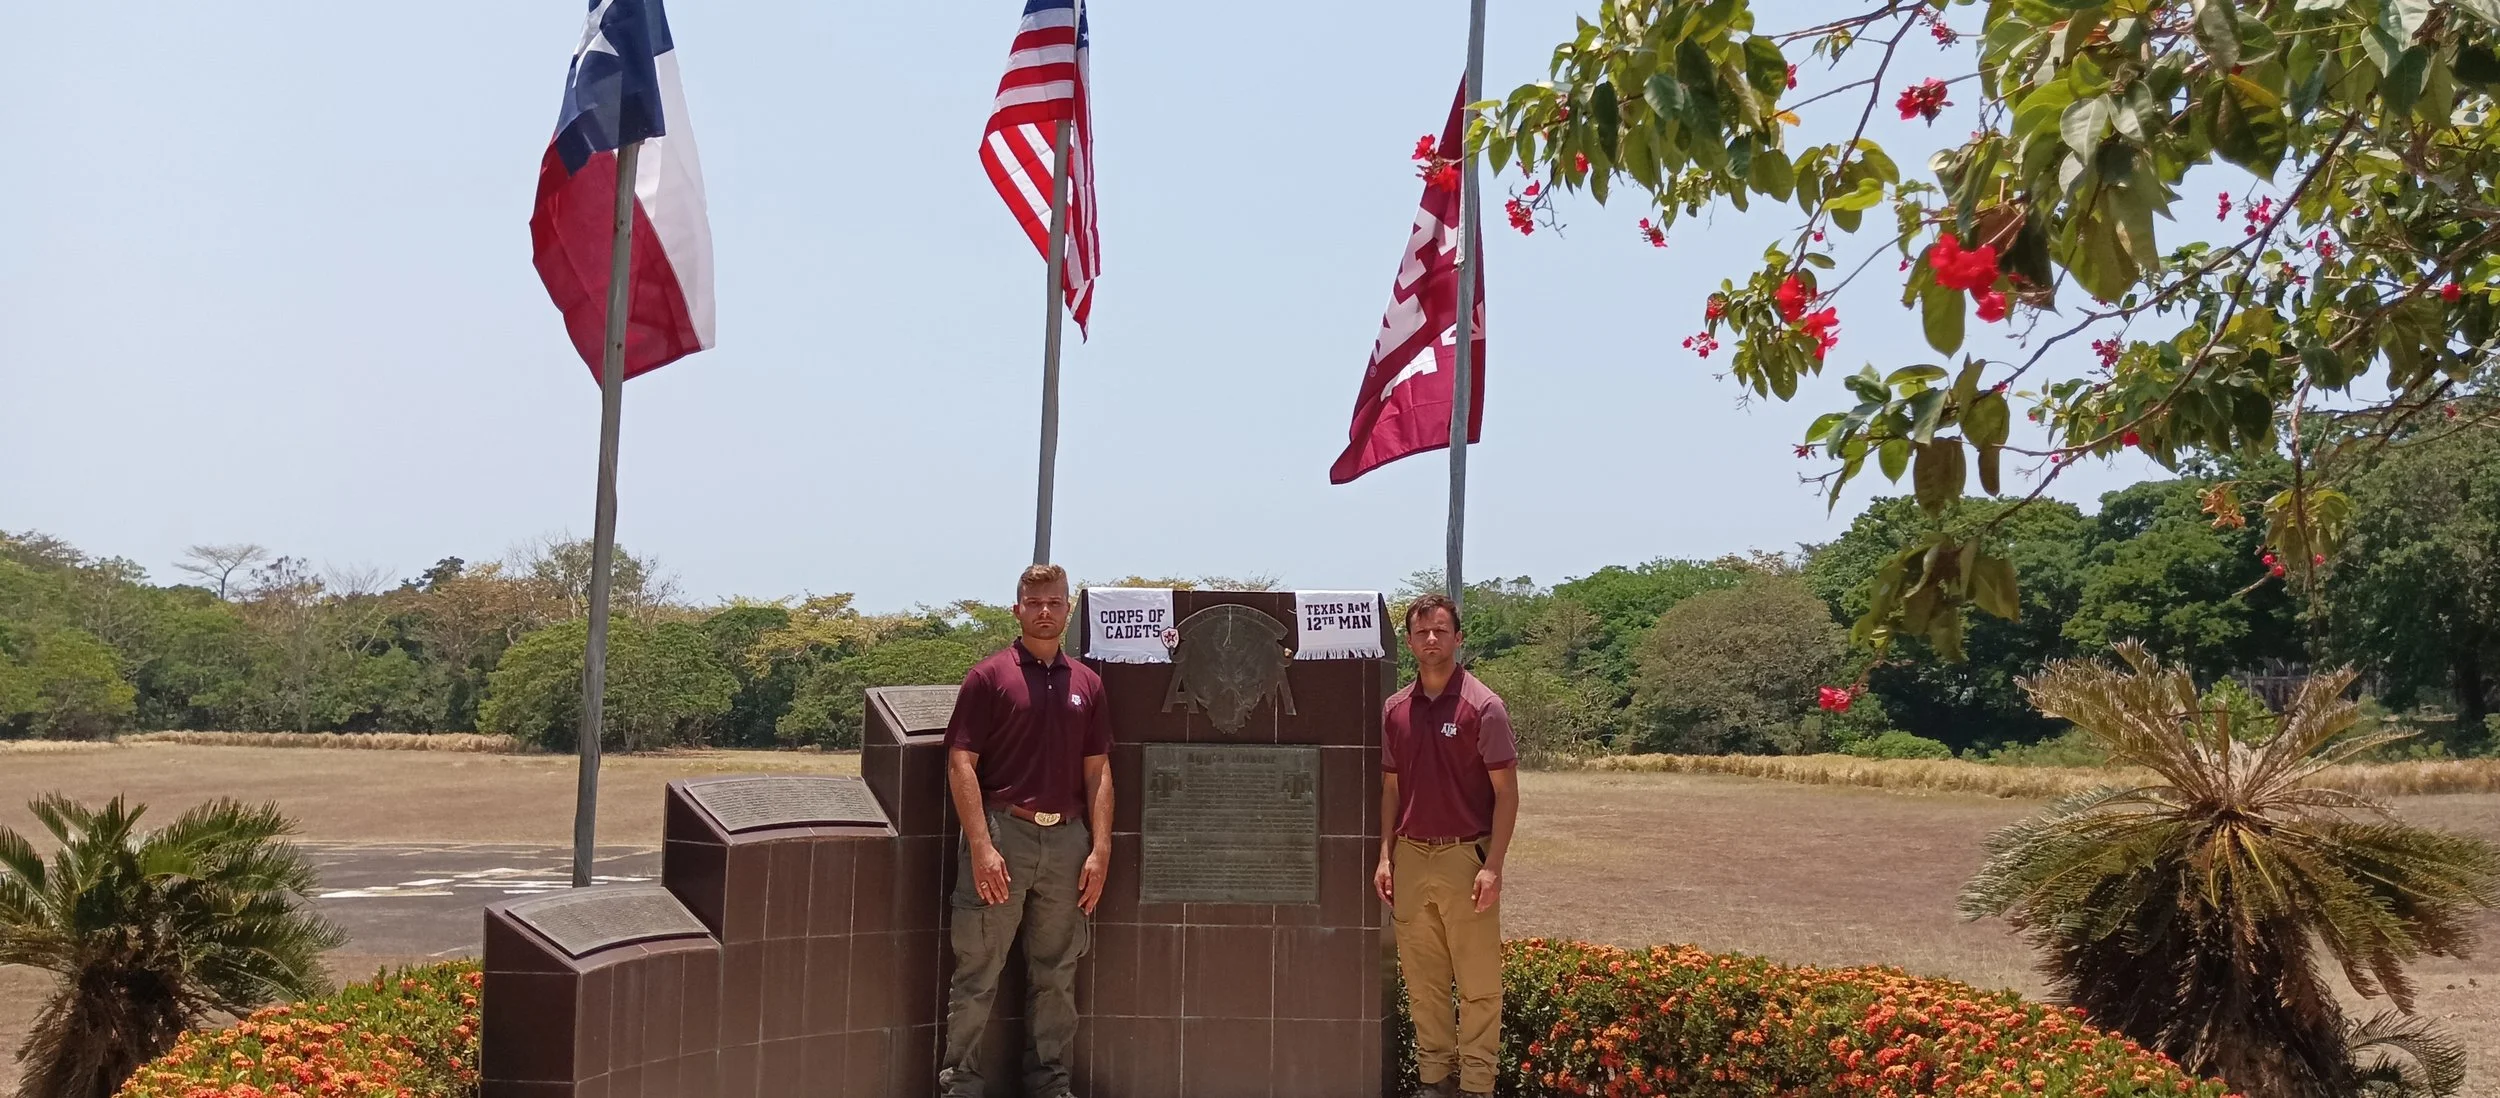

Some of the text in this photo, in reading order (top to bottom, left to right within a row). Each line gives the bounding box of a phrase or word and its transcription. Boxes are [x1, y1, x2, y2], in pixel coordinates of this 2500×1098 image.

[1100, 609, 1165, 624] CORPS OF
[1305, 603, 1344, 616] TEXAS
[1306, 615, 1372, 631] 12TH MAN
[1105, 624, 1161, 639] CADETS
